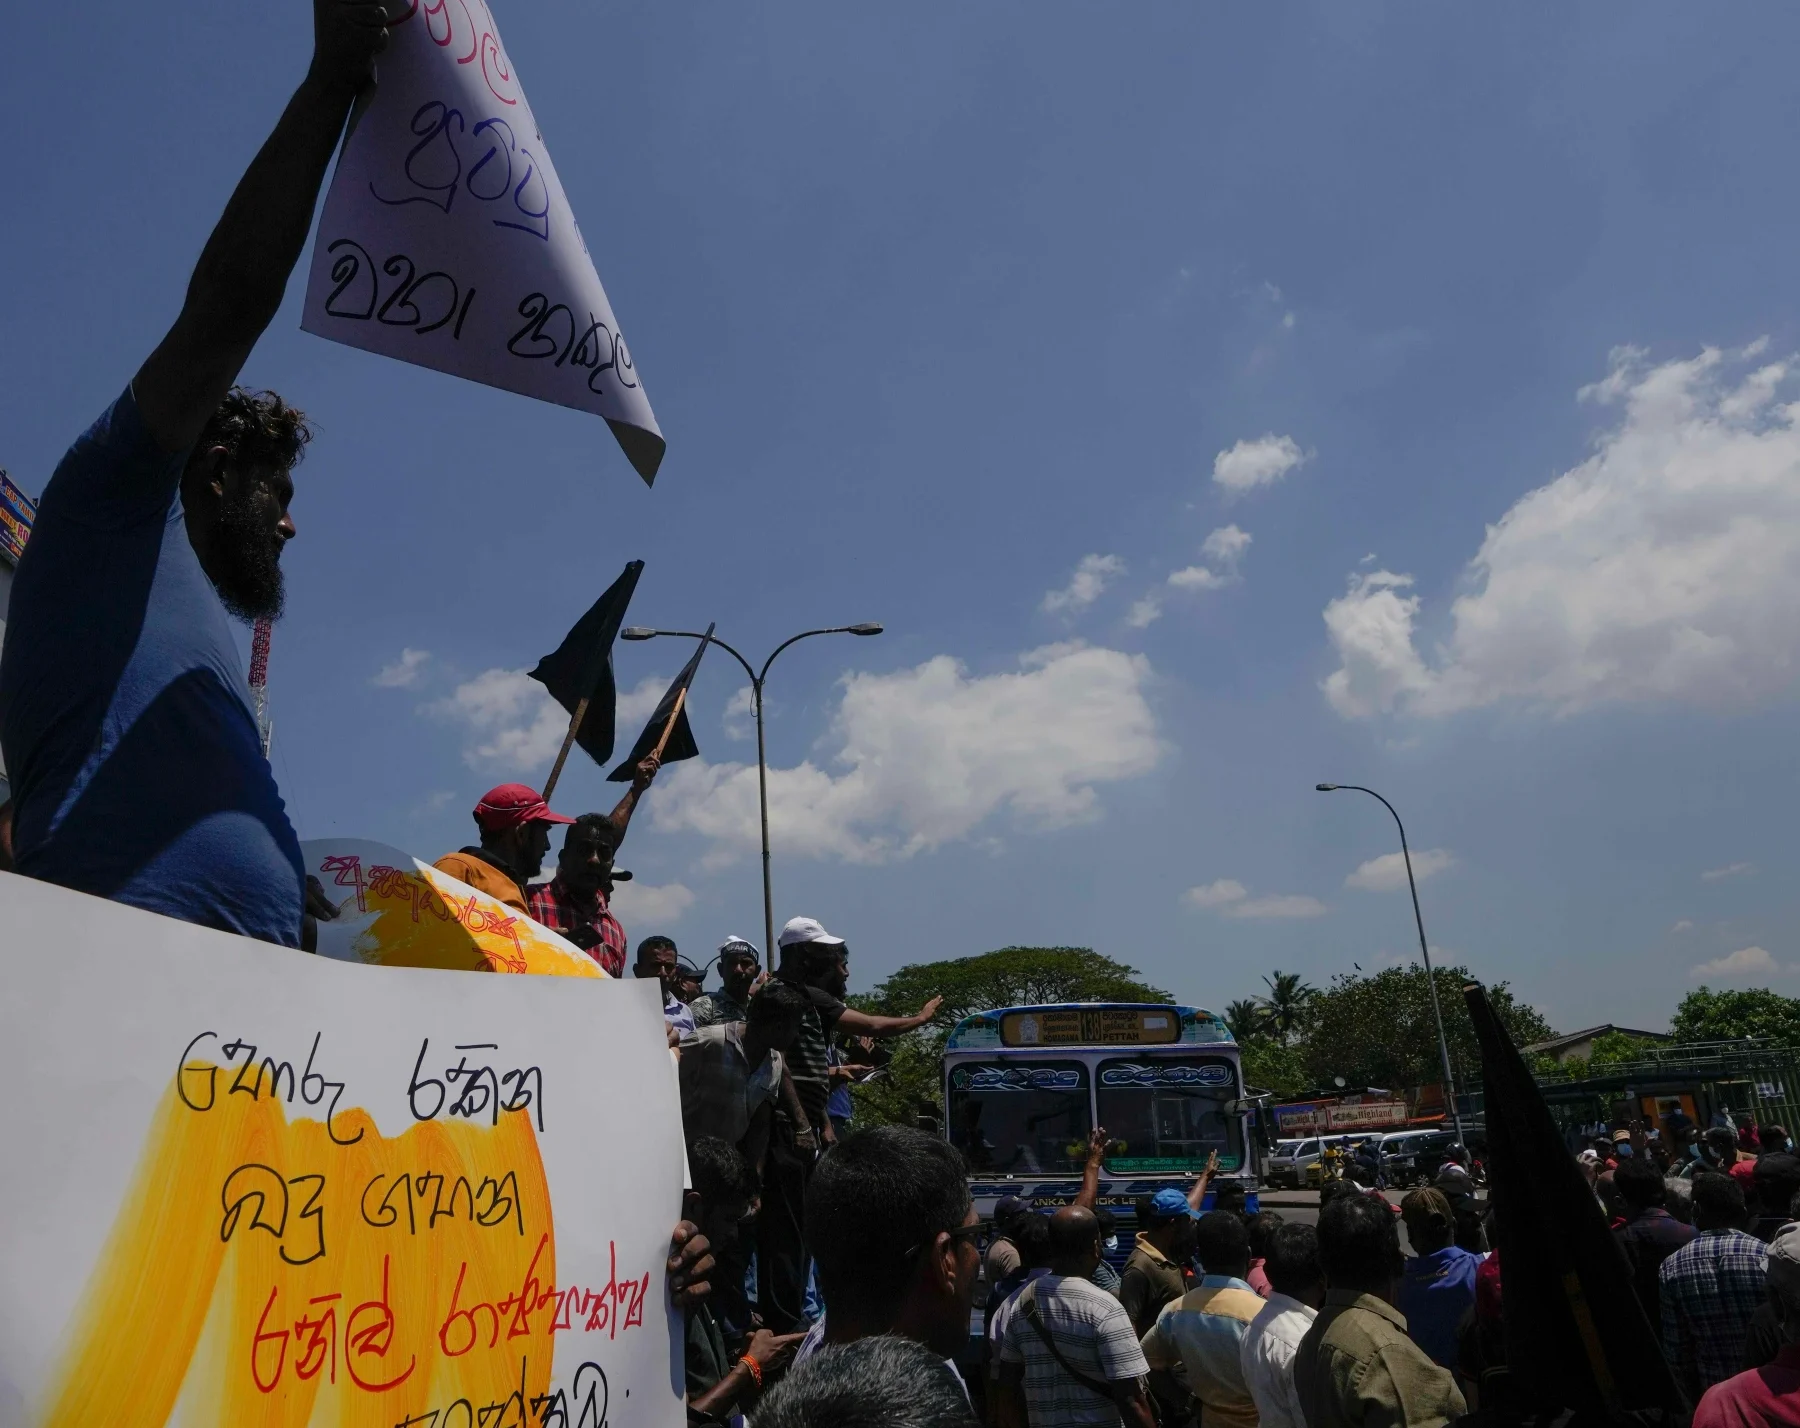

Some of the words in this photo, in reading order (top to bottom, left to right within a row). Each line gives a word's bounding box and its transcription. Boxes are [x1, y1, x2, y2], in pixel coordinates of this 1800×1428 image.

[1081, 1012, 1100, 1041] 138
[1102, 1032, 1139, 1041] PETTAH
[1358, 1109, 1392, 1121] Highland
[1034, 1198, 1067, 1206] ANKA
